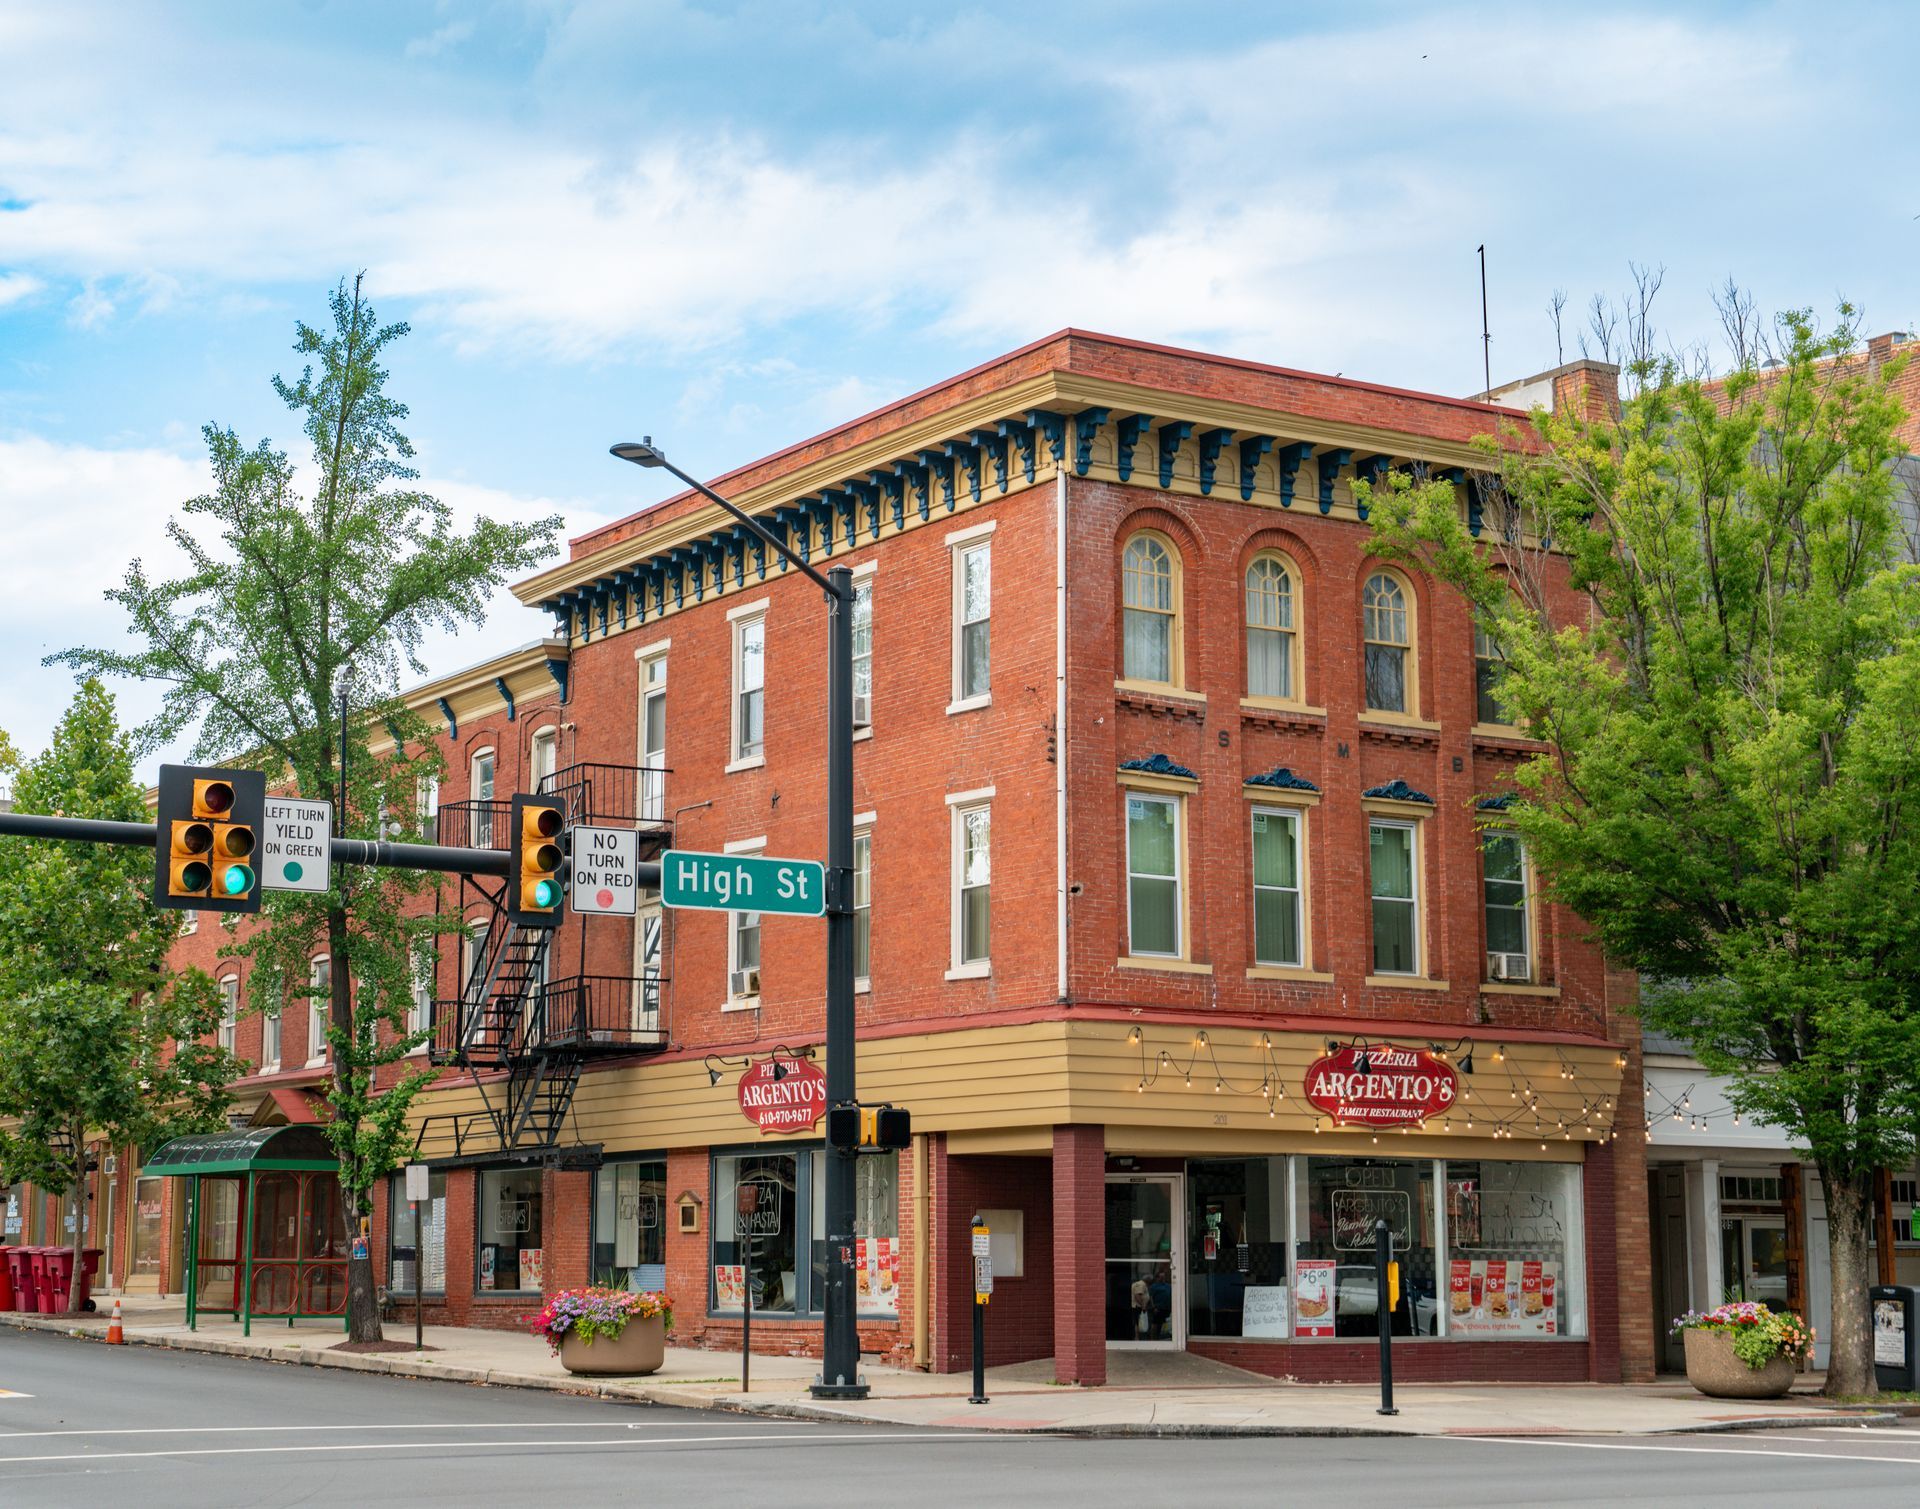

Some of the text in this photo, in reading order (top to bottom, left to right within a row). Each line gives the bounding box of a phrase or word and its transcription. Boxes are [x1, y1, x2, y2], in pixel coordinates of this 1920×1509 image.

[265, 806, 325, 822] LEFT TURN
[276, 823, 314, 840] YIELD
[265, 842, 322, 857] ON GREEN
[593, 833, 618, 850] NO
[587, 853, 624, 868] TURN
[577, 871, 633, 887] ON RED
[678, 860, 809, 904] High St
[760, 1061, 800, 1077] PIZRIA
[742, 1078, 826, 1107] ARGENTO'S
[1310, 1071, 1453, 1102] ARGENTO'S
[760, 1108, 812, 1125] 610-970-9677
[1337, 1106, 1424, 1119] FAMILY RESTAURANT
[1347, 1168, 1394, 1187] OPEN
